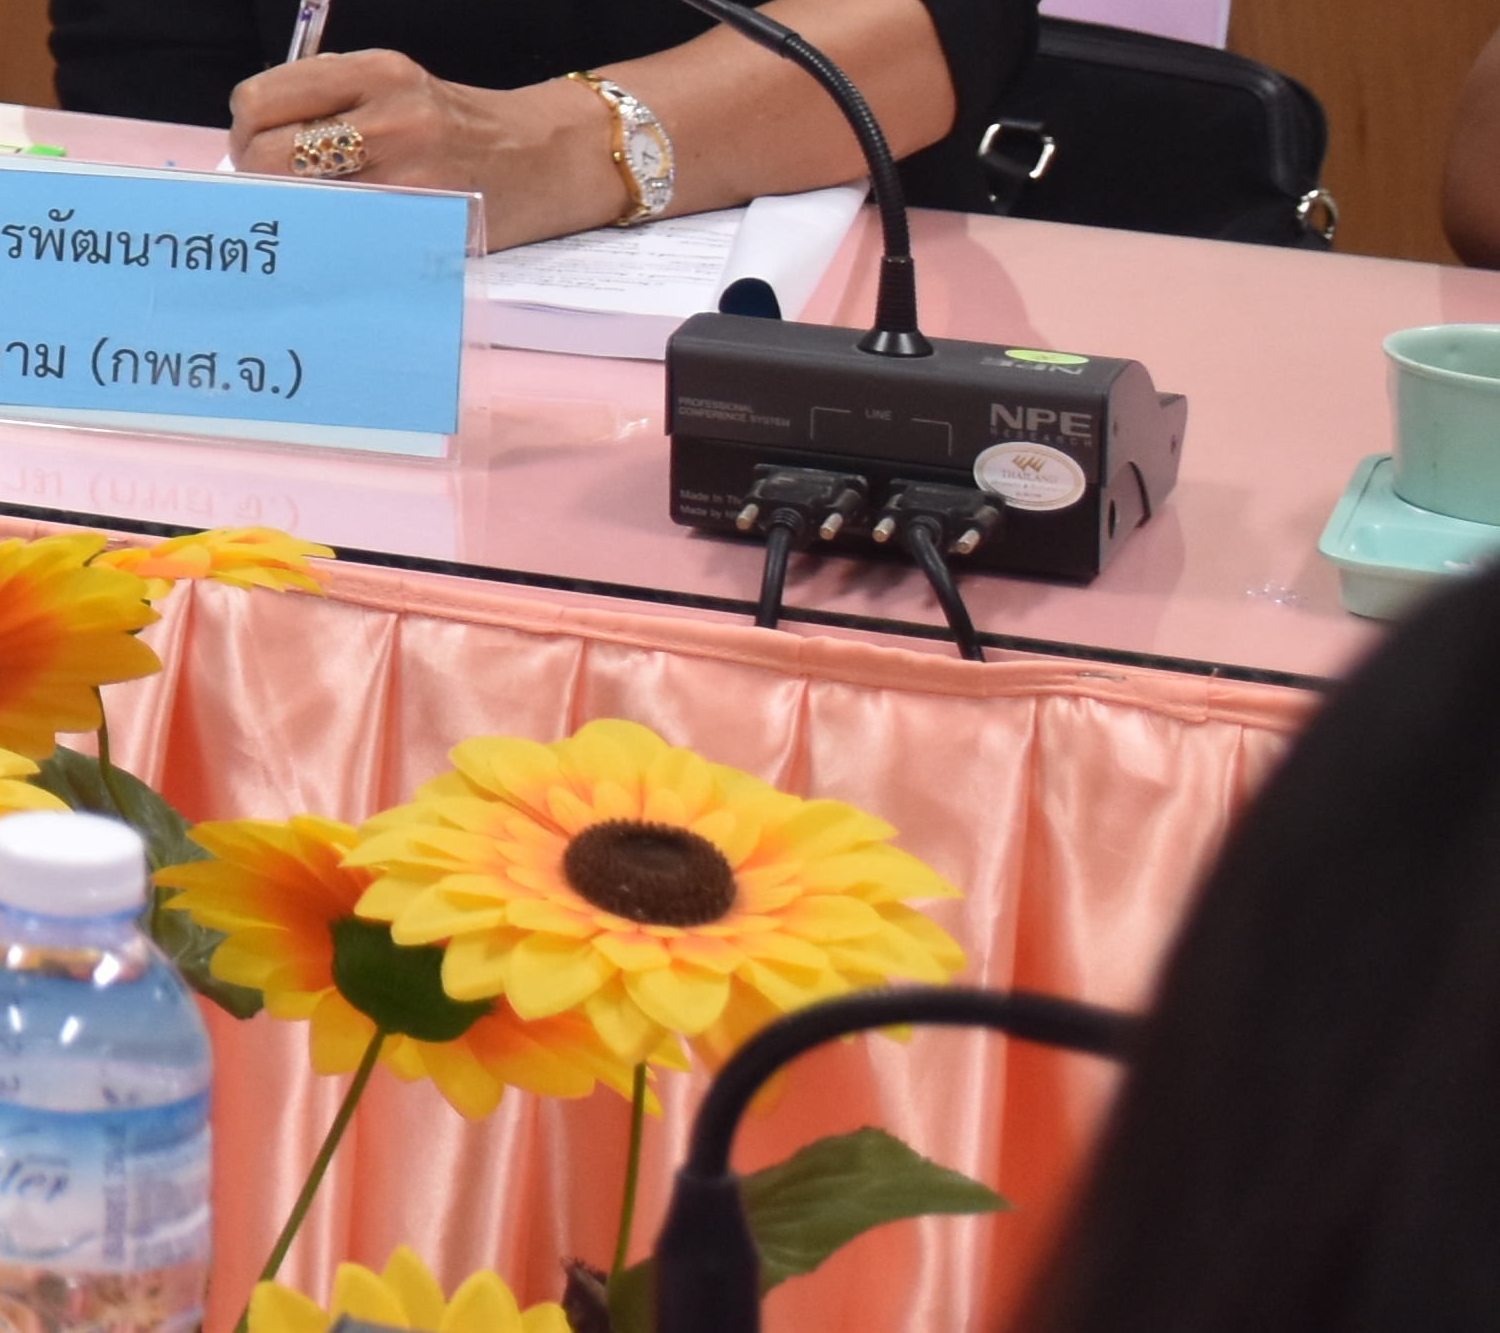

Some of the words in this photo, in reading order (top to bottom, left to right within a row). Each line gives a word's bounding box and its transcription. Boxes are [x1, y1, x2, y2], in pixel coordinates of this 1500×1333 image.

[91, 337, 303, 400] (กพส.จ.)
[865, 408, 892, 421] LINE
[990, 403, 1092, 438] NPE
